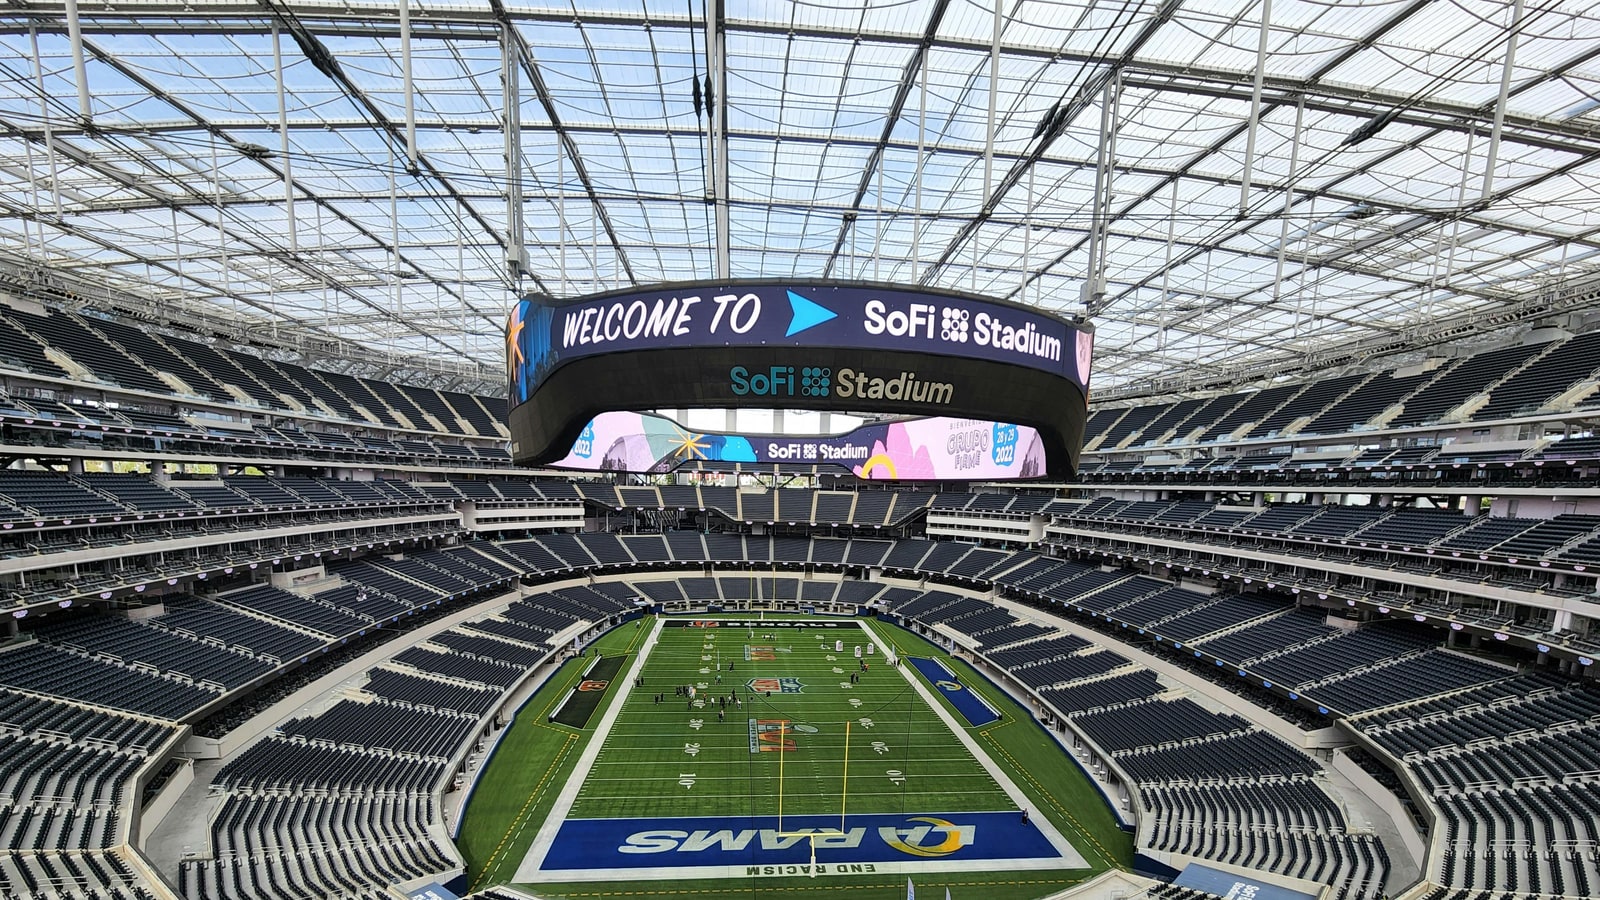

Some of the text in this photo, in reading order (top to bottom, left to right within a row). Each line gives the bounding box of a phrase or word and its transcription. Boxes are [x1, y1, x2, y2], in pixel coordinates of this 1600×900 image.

[563, 293, 762, 349] WELCOME TO
[863, 299, 1061, 362] SoFi Stadium
[730, 366, 954, 404] SoFi Stadium
[947, 430, 989, 455] GRUPO
[1007, 428, 1015, 441] 29
[574, 439, 591, 455] 2022
[768, 443, 868, 459] SoFi Stadium
[996, 446, 1013, 462] 2022
[684, 742, 700, 754] 20
[871, 741, 889, 752] 20
[679, 773, 696, 785] 10
[886, 769, 906, 781] 10
[618, 826, 867, 854] RAMS
[747, 864, 876, 876] END RACISM
